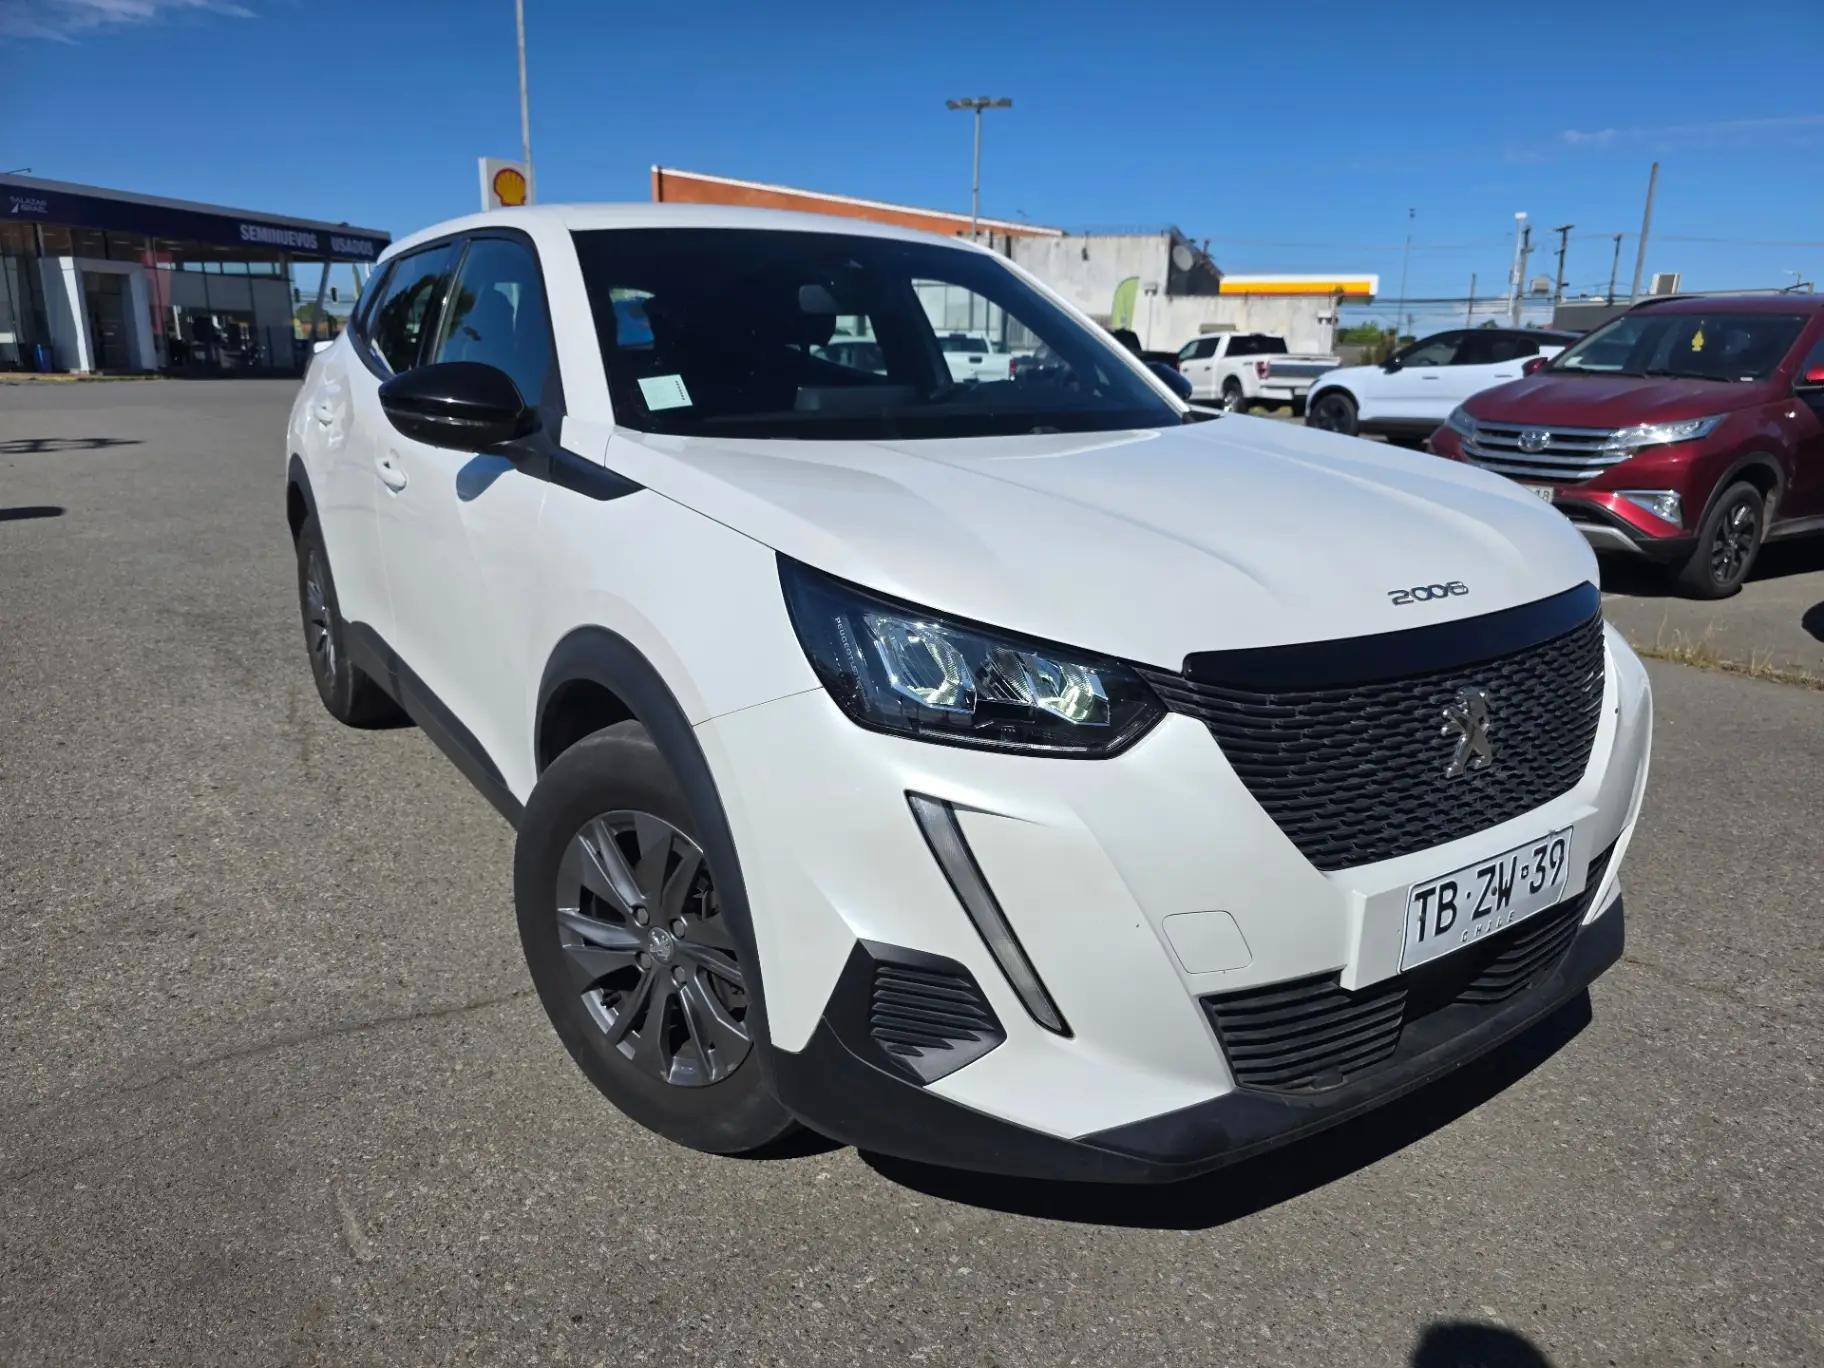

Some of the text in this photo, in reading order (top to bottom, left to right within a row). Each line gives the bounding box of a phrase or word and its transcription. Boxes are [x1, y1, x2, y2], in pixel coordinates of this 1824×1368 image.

[240, 224, 374, 256] SEMINUEVOS USADOS
[1387, 581, 1469, 605] 2008
[1461, 911, 1515, 943] CHILE
